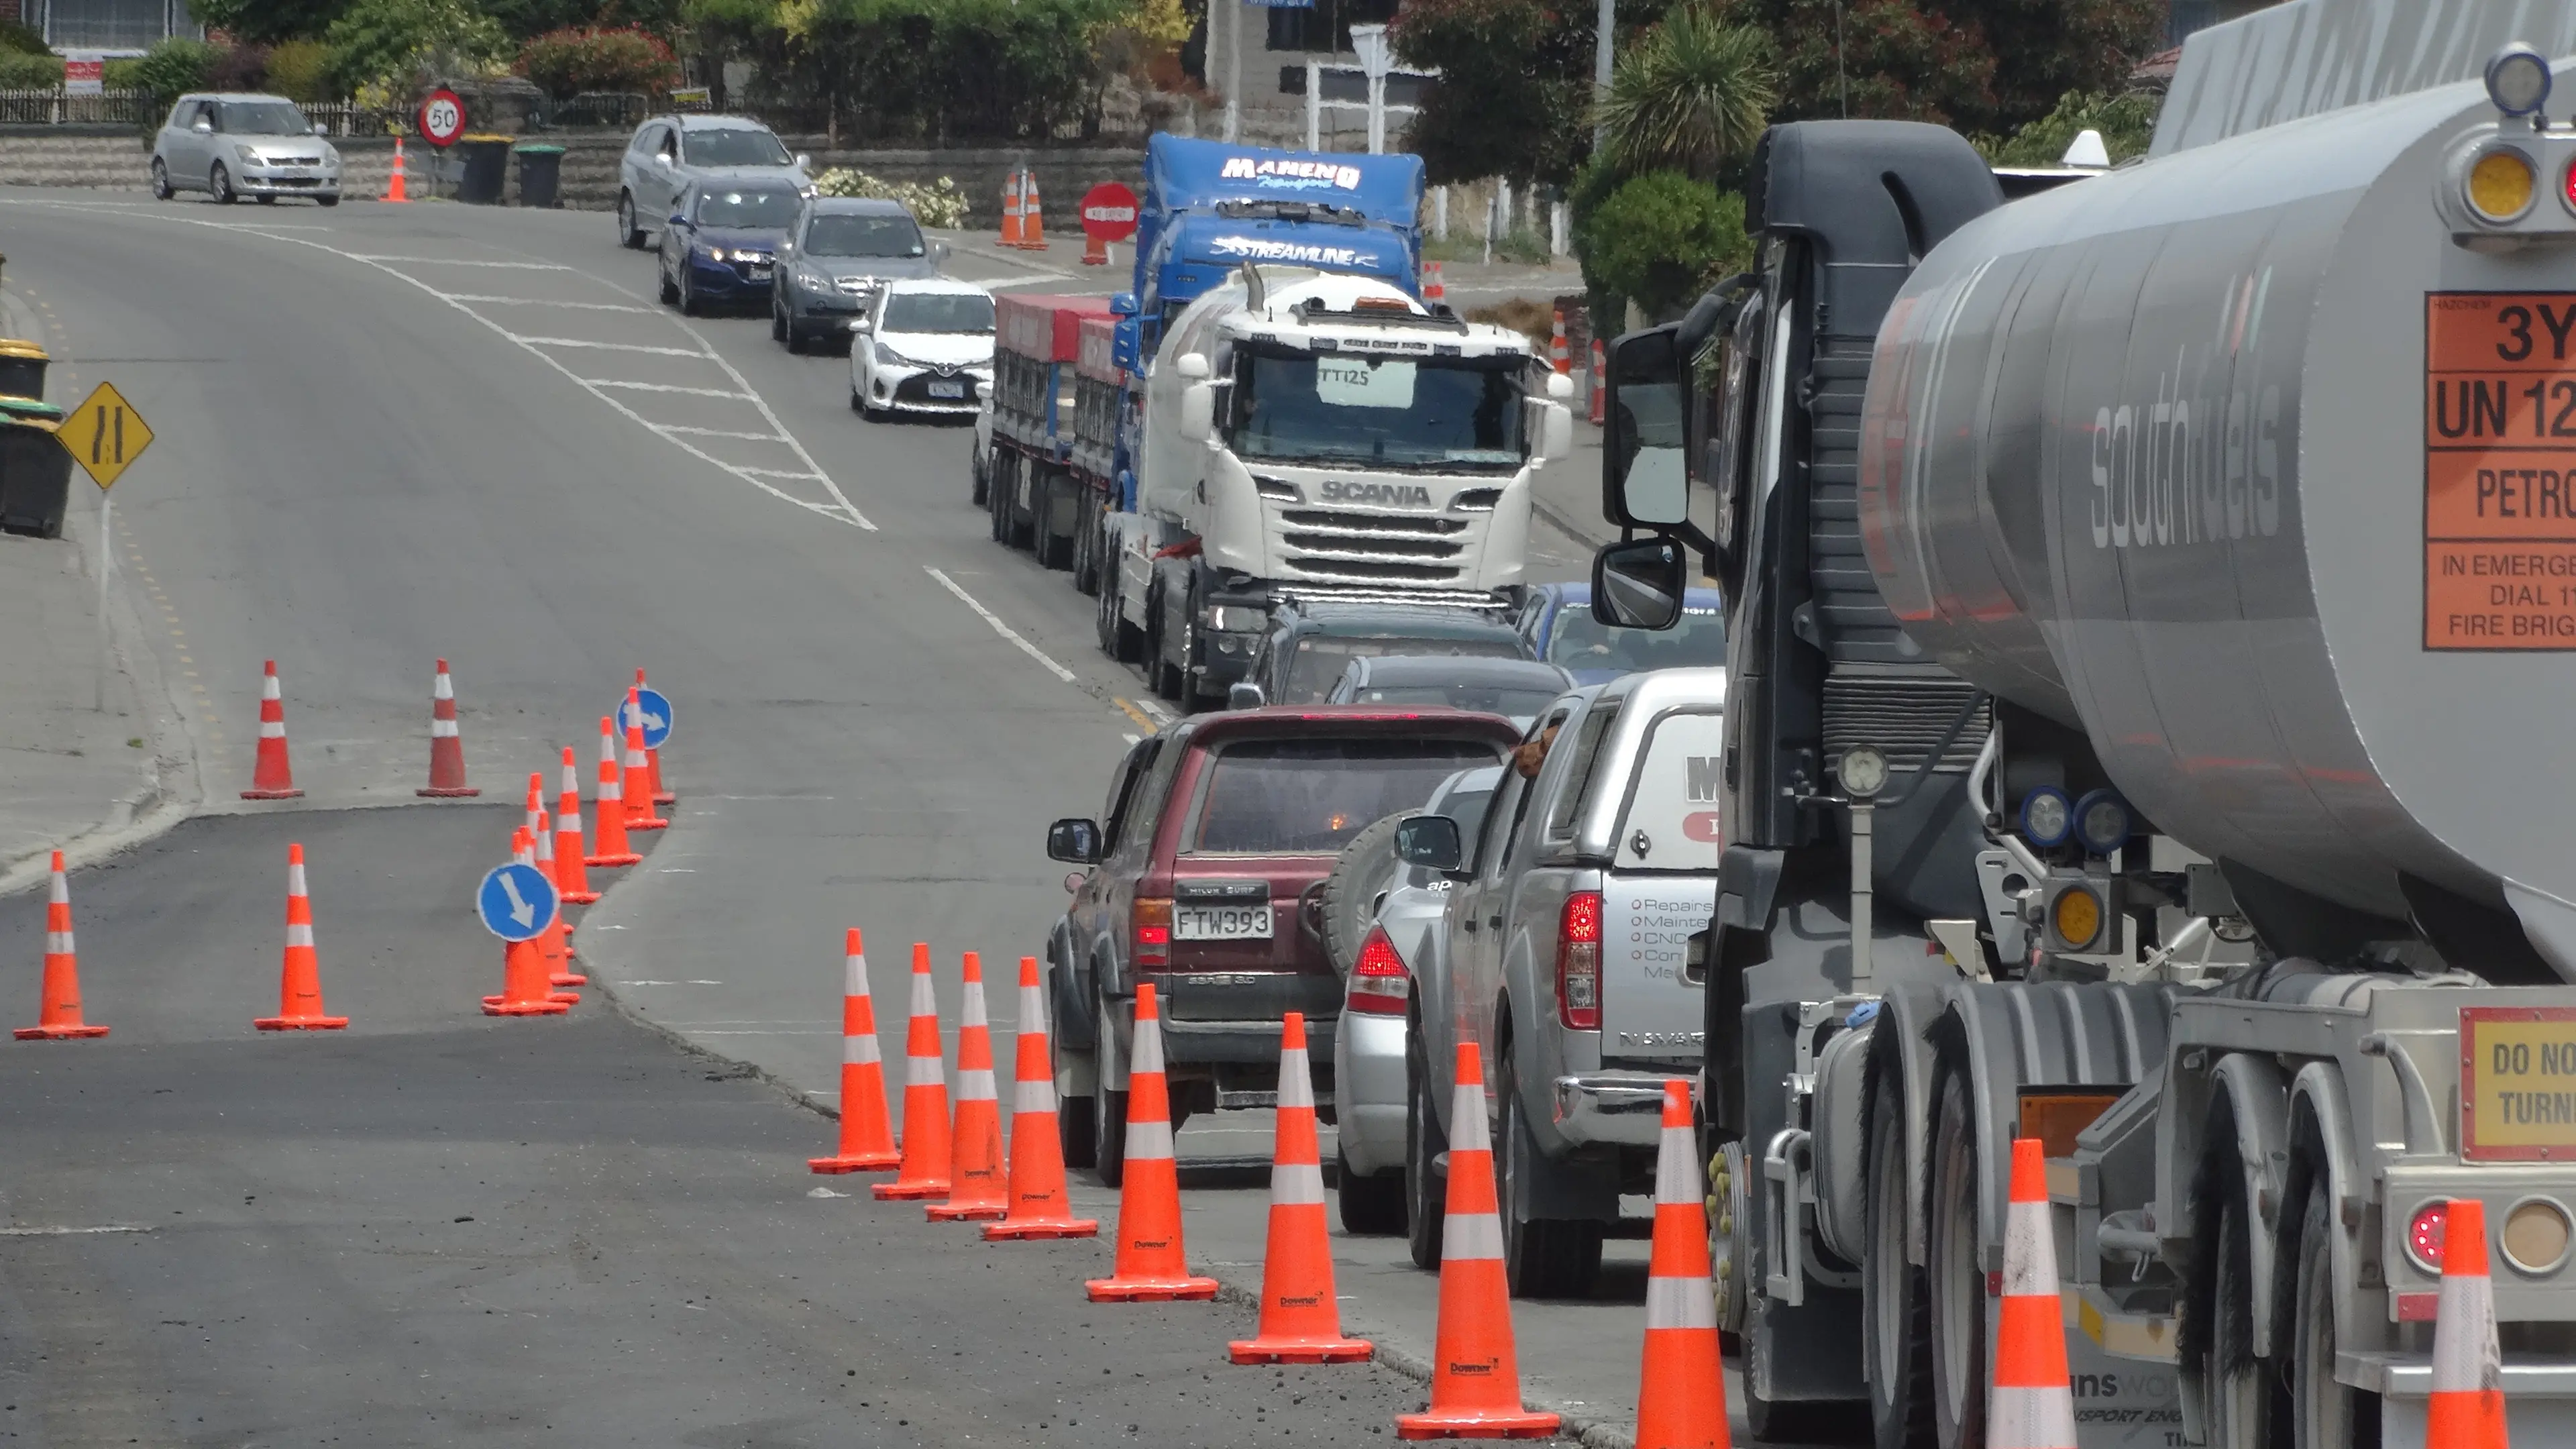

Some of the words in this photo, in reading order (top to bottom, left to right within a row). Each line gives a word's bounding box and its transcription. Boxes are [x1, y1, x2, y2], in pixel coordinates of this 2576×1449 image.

[432, 108, 455, 129] 50
[1230, 236, 1356, 266] STREAMLINE
[2496, 303, 2576, 361] 3Y
[2436, 380, 2507, 438] UN
[1320, 479, 1432, 506] SCANIA
[2443, 554, 2465, 576] IN
[2489, 584, 2551, 606] DIAL
[2449, 613, 2505, 637] FIRE
[2512, 613, 2576, 637] BRIG
[1226, 885, 1256, 895] SURF
[1427, 880, 1452, 892] ap
[1644, 899, 1713, 912] Repairs
[1178, 910, 1269, 935] FTW393
[1644, 916, 1709, 928] Mainte
[1644, 932, 1686, 945] CNC
[2493, 1042, 2530, 1075] DO
[2498, 1091, 2576, 1126] TURN
